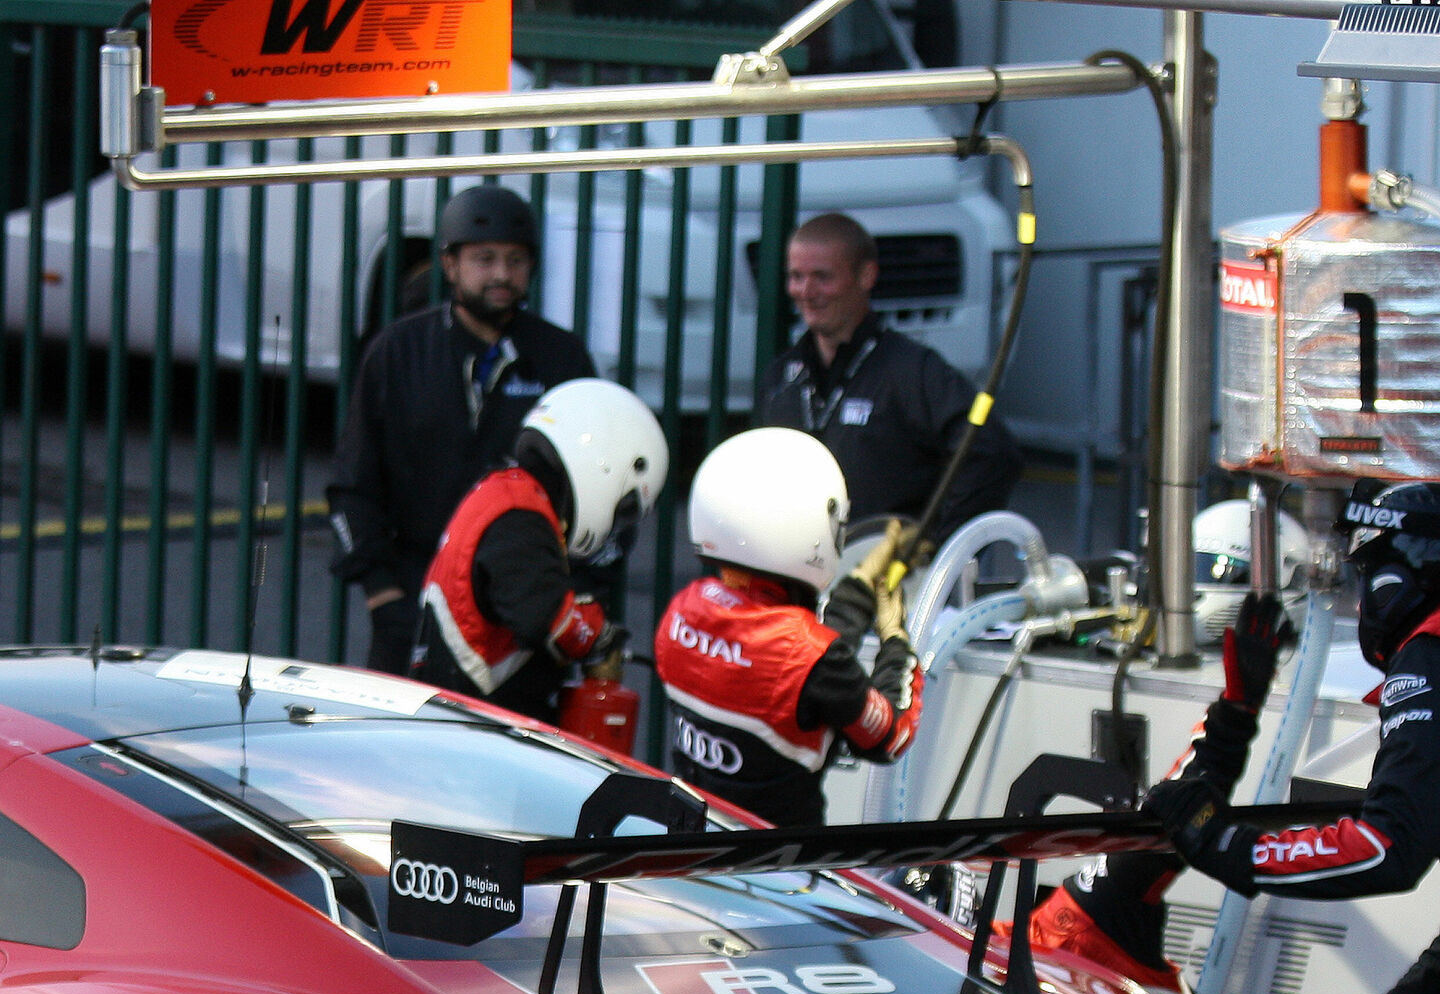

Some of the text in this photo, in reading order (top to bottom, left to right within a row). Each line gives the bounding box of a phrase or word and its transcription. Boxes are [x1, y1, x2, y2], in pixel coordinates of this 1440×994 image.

[231, 58, 451, 78] w-racingteam.com
[1222, 266, 1276, 308] OTAL
[1345, 501, 1408, 529] uvex
[669, 612, 753, 668] TOTAL
[1252, 837, 1339, 865] OTAL
[465, 875, 500, 893] Belgian
[465, 892, 516, 913] Audi Club
